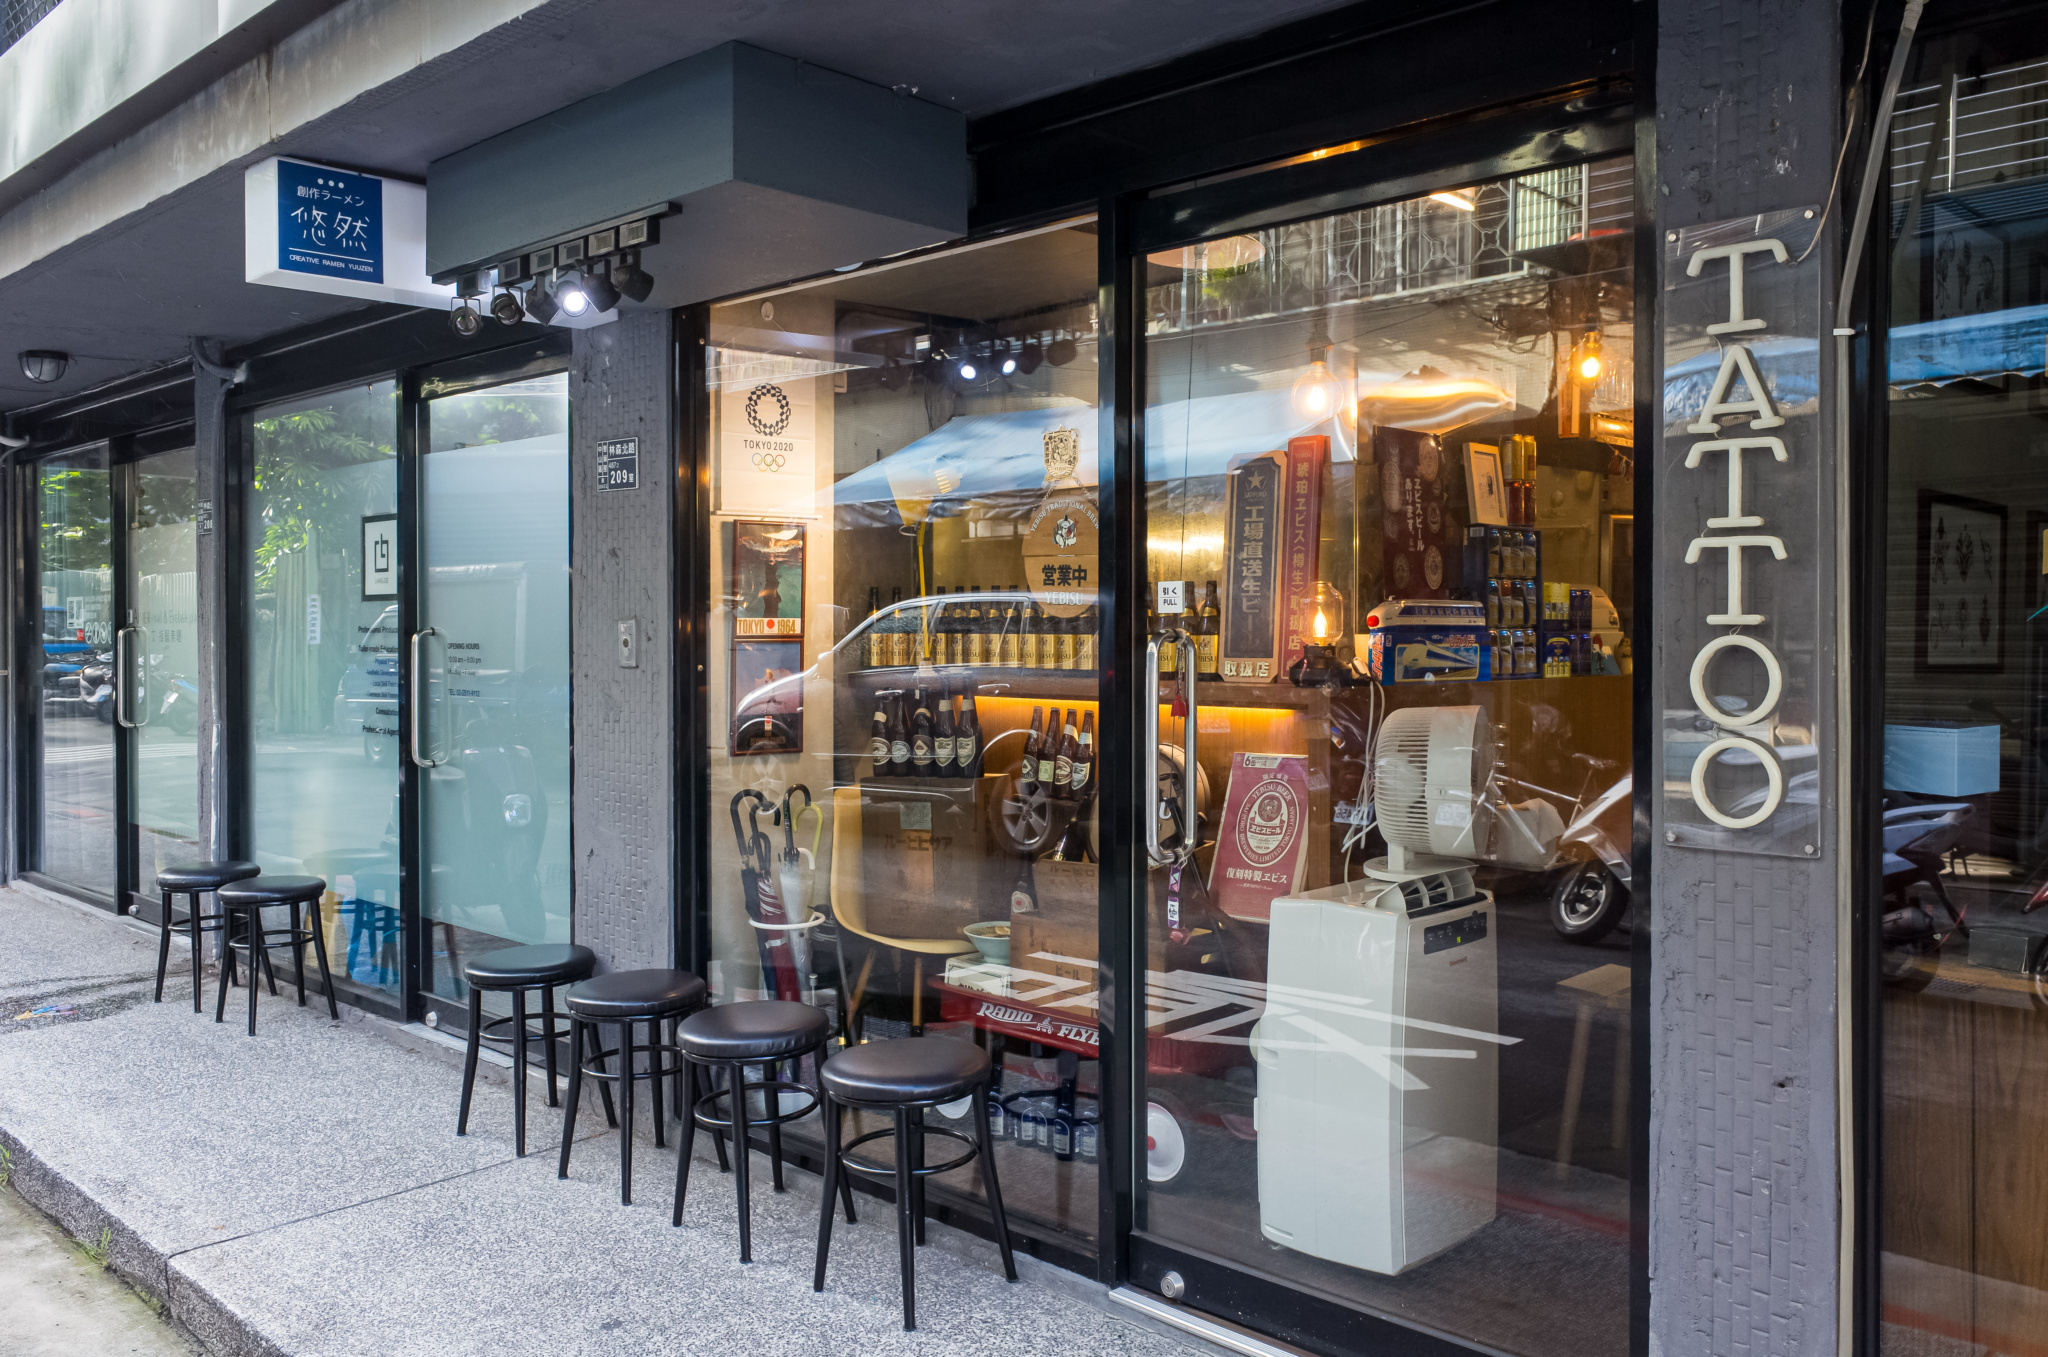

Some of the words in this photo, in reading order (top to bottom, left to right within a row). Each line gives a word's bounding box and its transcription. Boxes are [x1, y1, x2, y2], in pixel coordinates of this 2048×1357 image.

[296, 185, 365, 207] 創作ラーメン
[291, 205, 371, 252] 悠然
[289, 254, 320, 265] CREATIVE
[322, 259, 345, 269] RAMEN
[348, 263, 374, 273] YUUZEN
[608, 442, 635, 456] 林森北路
[743, 439, 772, 450] TOKYO
[773, 442, 793, 452] 2020
[1030, 509, 1047, 533] YEBISU
[1047, 499, 1087, 515] TRADITIONAL
[1685, 237, 1790, 830] TATTOO
[1041, 564, 1088, 588] 営業中
[1045, 591, 1084, 606] YEBISU
[1163, 598, 1178, 606] PULL
[737, 618, 765, 635] TOKYO
[776, 619, 797, 635] 1964
[447, 642, 465, 650] OPENING
[465, 642, 480, 650] HOURS
[1223, 661, 1271, 678] 取扱店
[1251, 783, 1276, 800] YEBISU
[1276, 784, 1292, 802] BEER
[1250, 824, 1282, 835] ヱビスビール
[1259, 847, 1282, 862] LIMITED
[1226, 867, 1288, 884] 復刻特製ヱビス
[976, 1001, 1034, 1023] RADIO
[1057, 1025, 1100, 1046] FLYE
